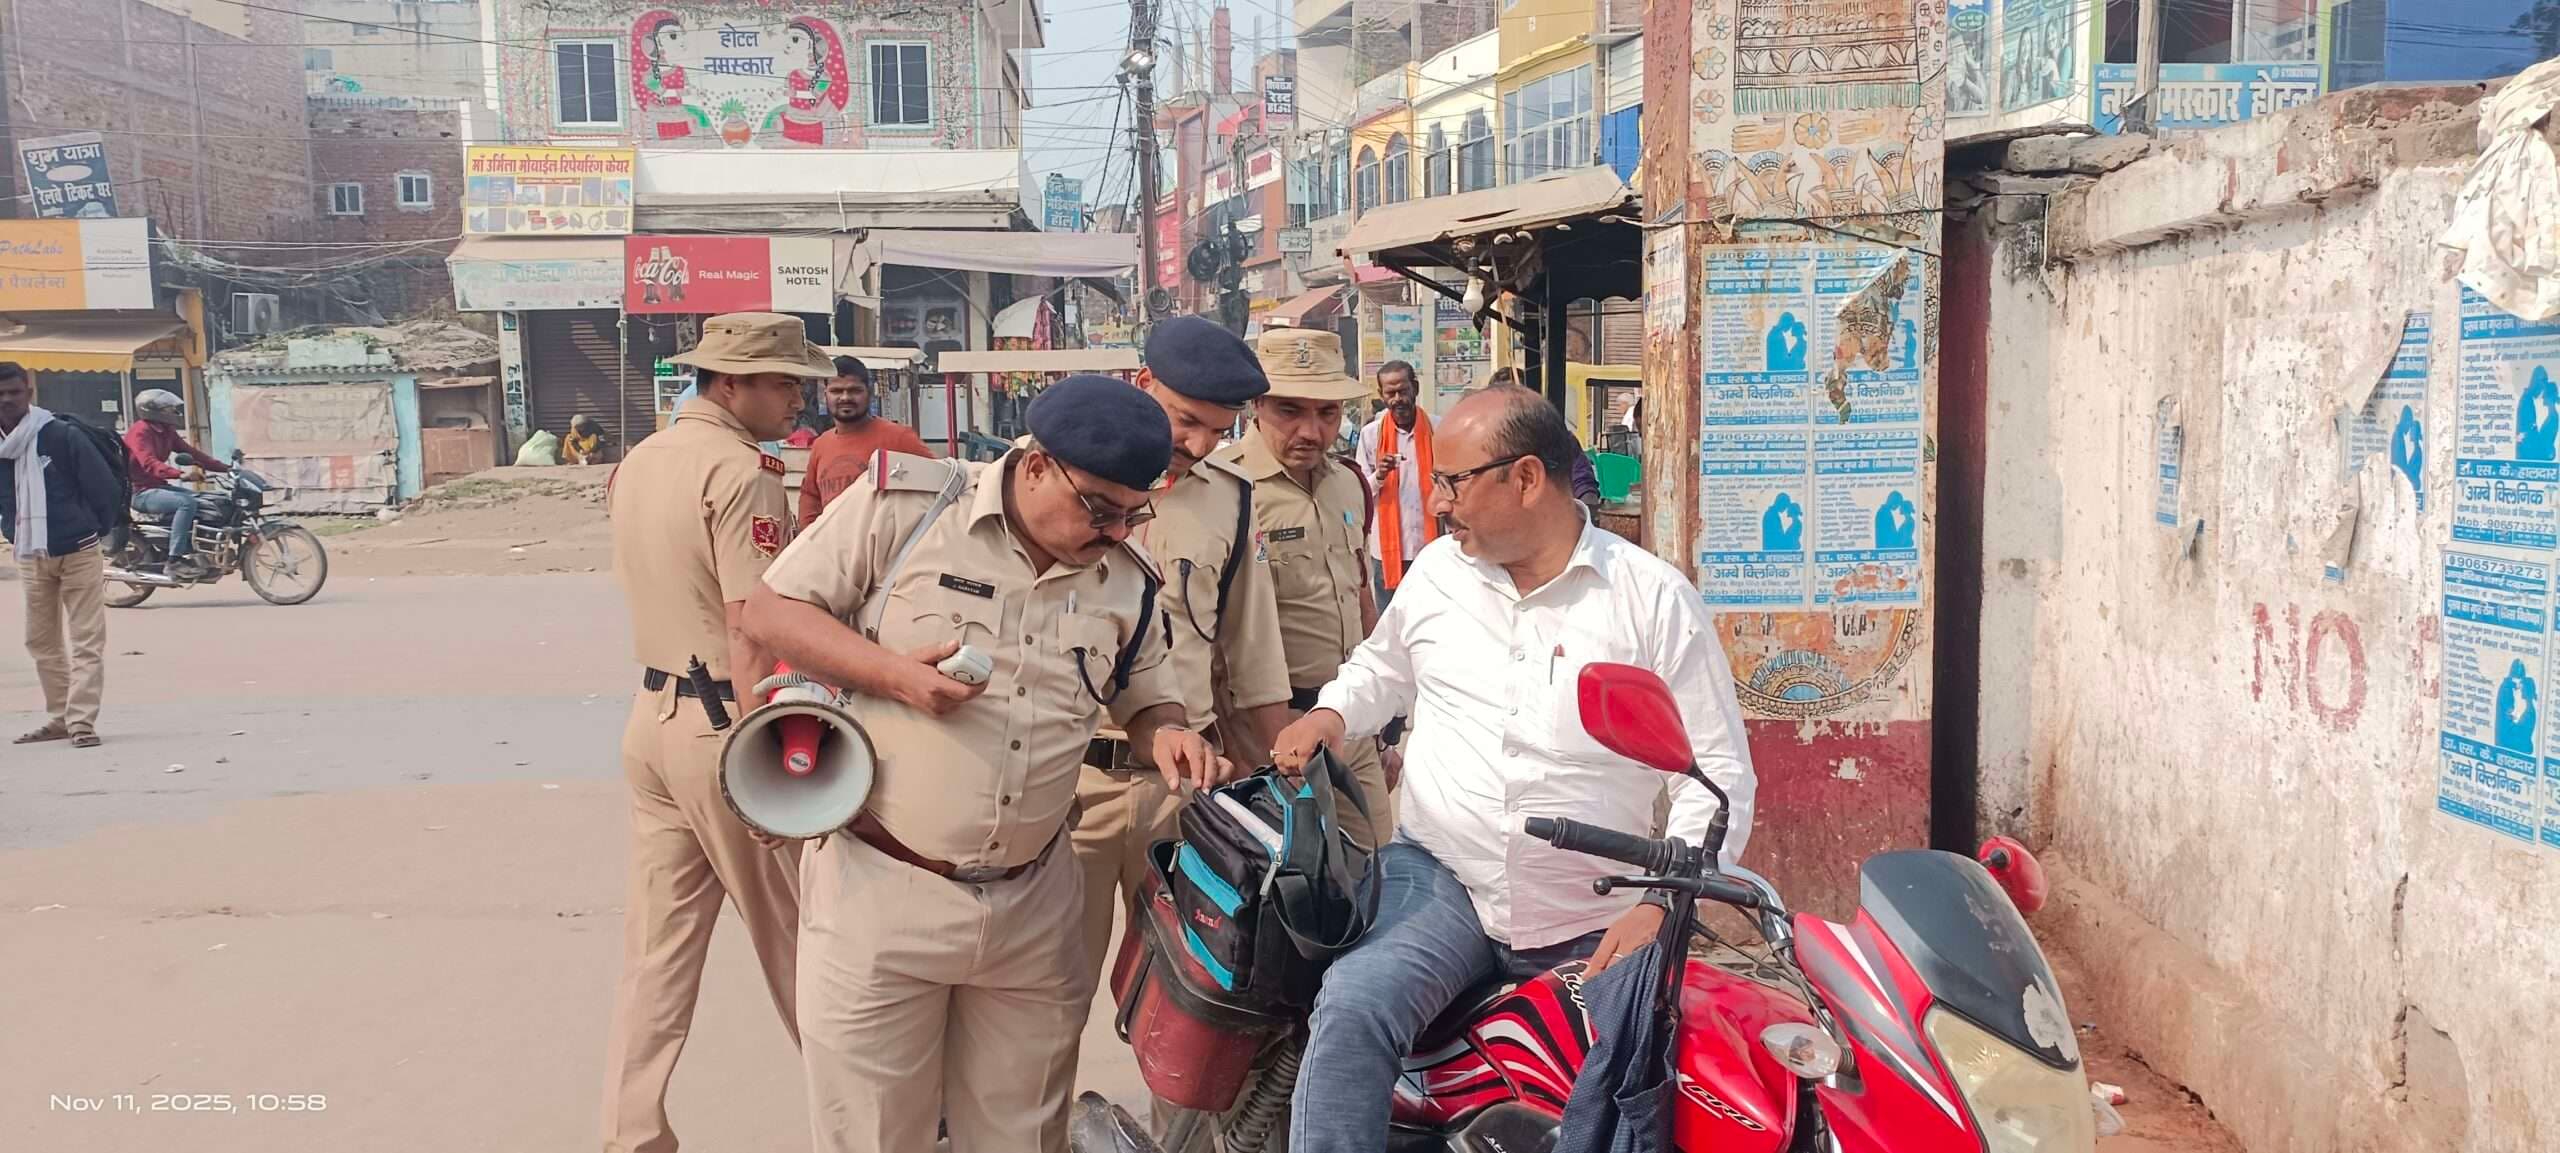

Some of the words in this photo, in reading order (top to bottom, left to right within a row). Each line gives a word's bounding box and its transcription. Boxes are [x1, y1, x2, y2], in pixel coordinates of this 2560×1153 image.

[718, 22, 760, 48] होटल
[704, 57, 774, 75] नमस्कार
[61, 143, 101, 160] यात्रा
[486, 154, 517, 173] उर्मिला
[605, 154, 630, 173] केयर
[34, 182, 64, 206] रेलवे
[65, 182, 95, 203] टिकट
[96, 182, 112, 198] घर
[698, 270, 723, 279] Real
[727, 270, 759, 281] Magic
[778, 266, 829, 275] SANTOSH
[787, 277, 821, 286] HOTEL
[2465, 481, 2490, 501] अम्बे
[2495, 480, 2545, 504] क्लिनिक
[1743, 564, 1793, 579] क्लिनिक
[2457, 556, 2544, 579] 9065733273
[2252, 602, 2368, 730] NO
[2449, 760, 2473, 781] अम्बे
[2475, 762, 2522, 795] क्लिनिक
